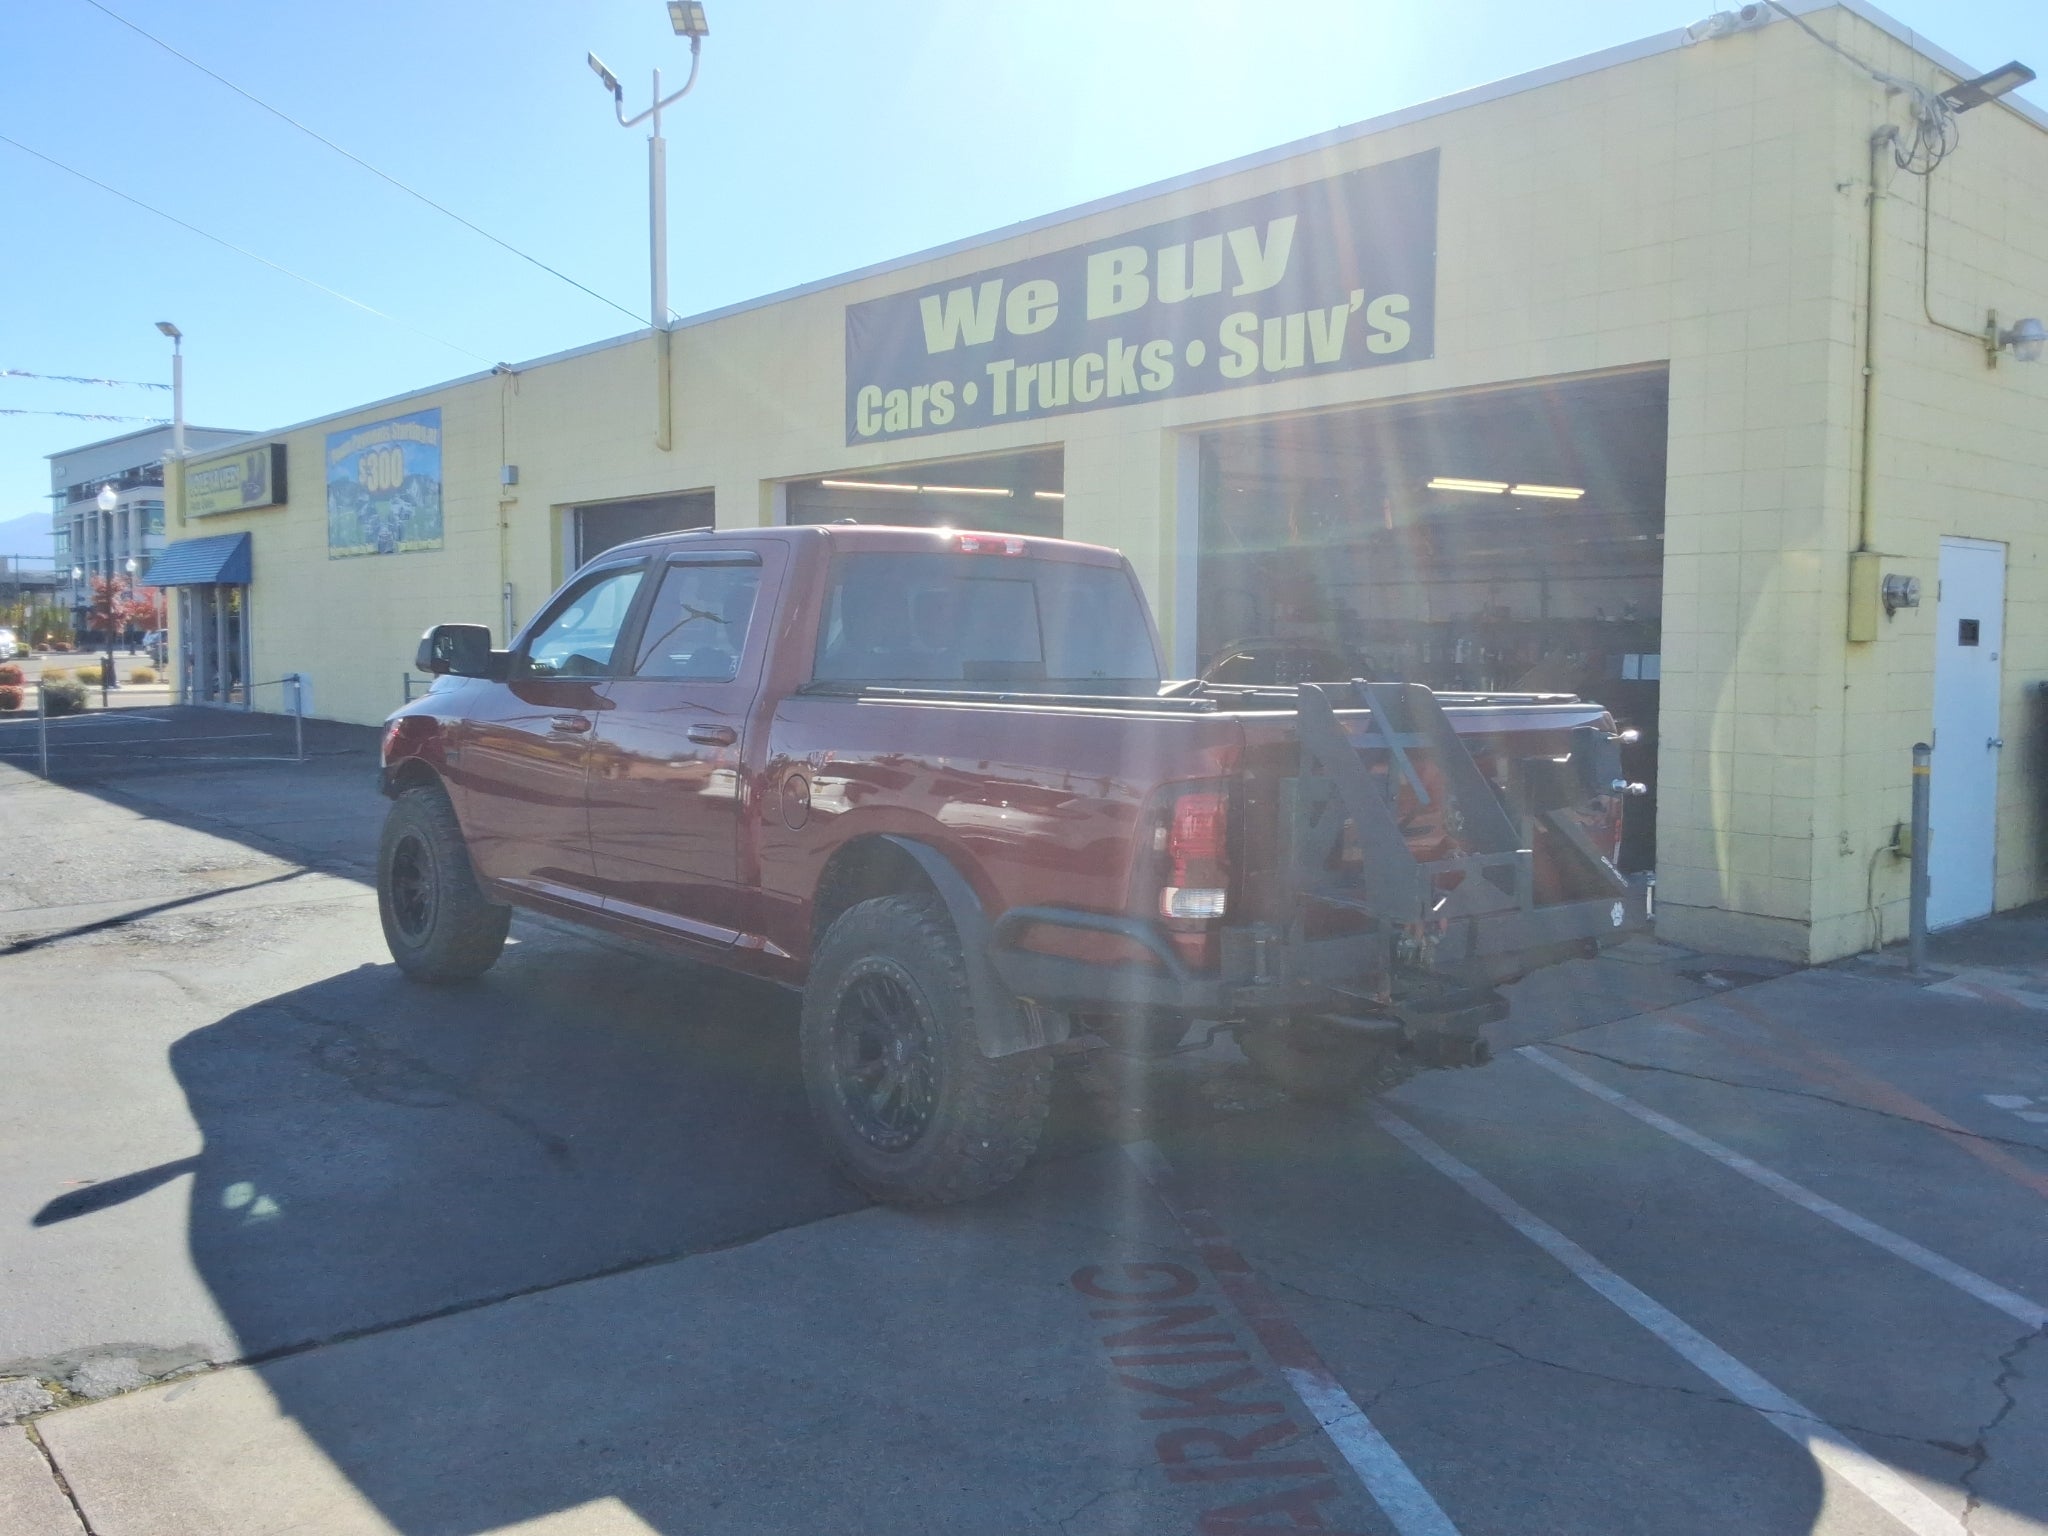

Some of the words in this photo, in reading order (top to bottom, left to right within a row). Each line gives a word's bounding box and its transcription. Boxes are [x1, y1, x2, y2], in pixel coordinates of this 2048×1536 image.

[920, 279, 1058, 354] We
[1087, 215, 1298, 320] Buy
[857, 380, 955, 436] Cars
[986, 338, 1174, 416] Trucks
[1219, 288, 1410, 379] Suv's
[358, 447, 404, 492] $300
